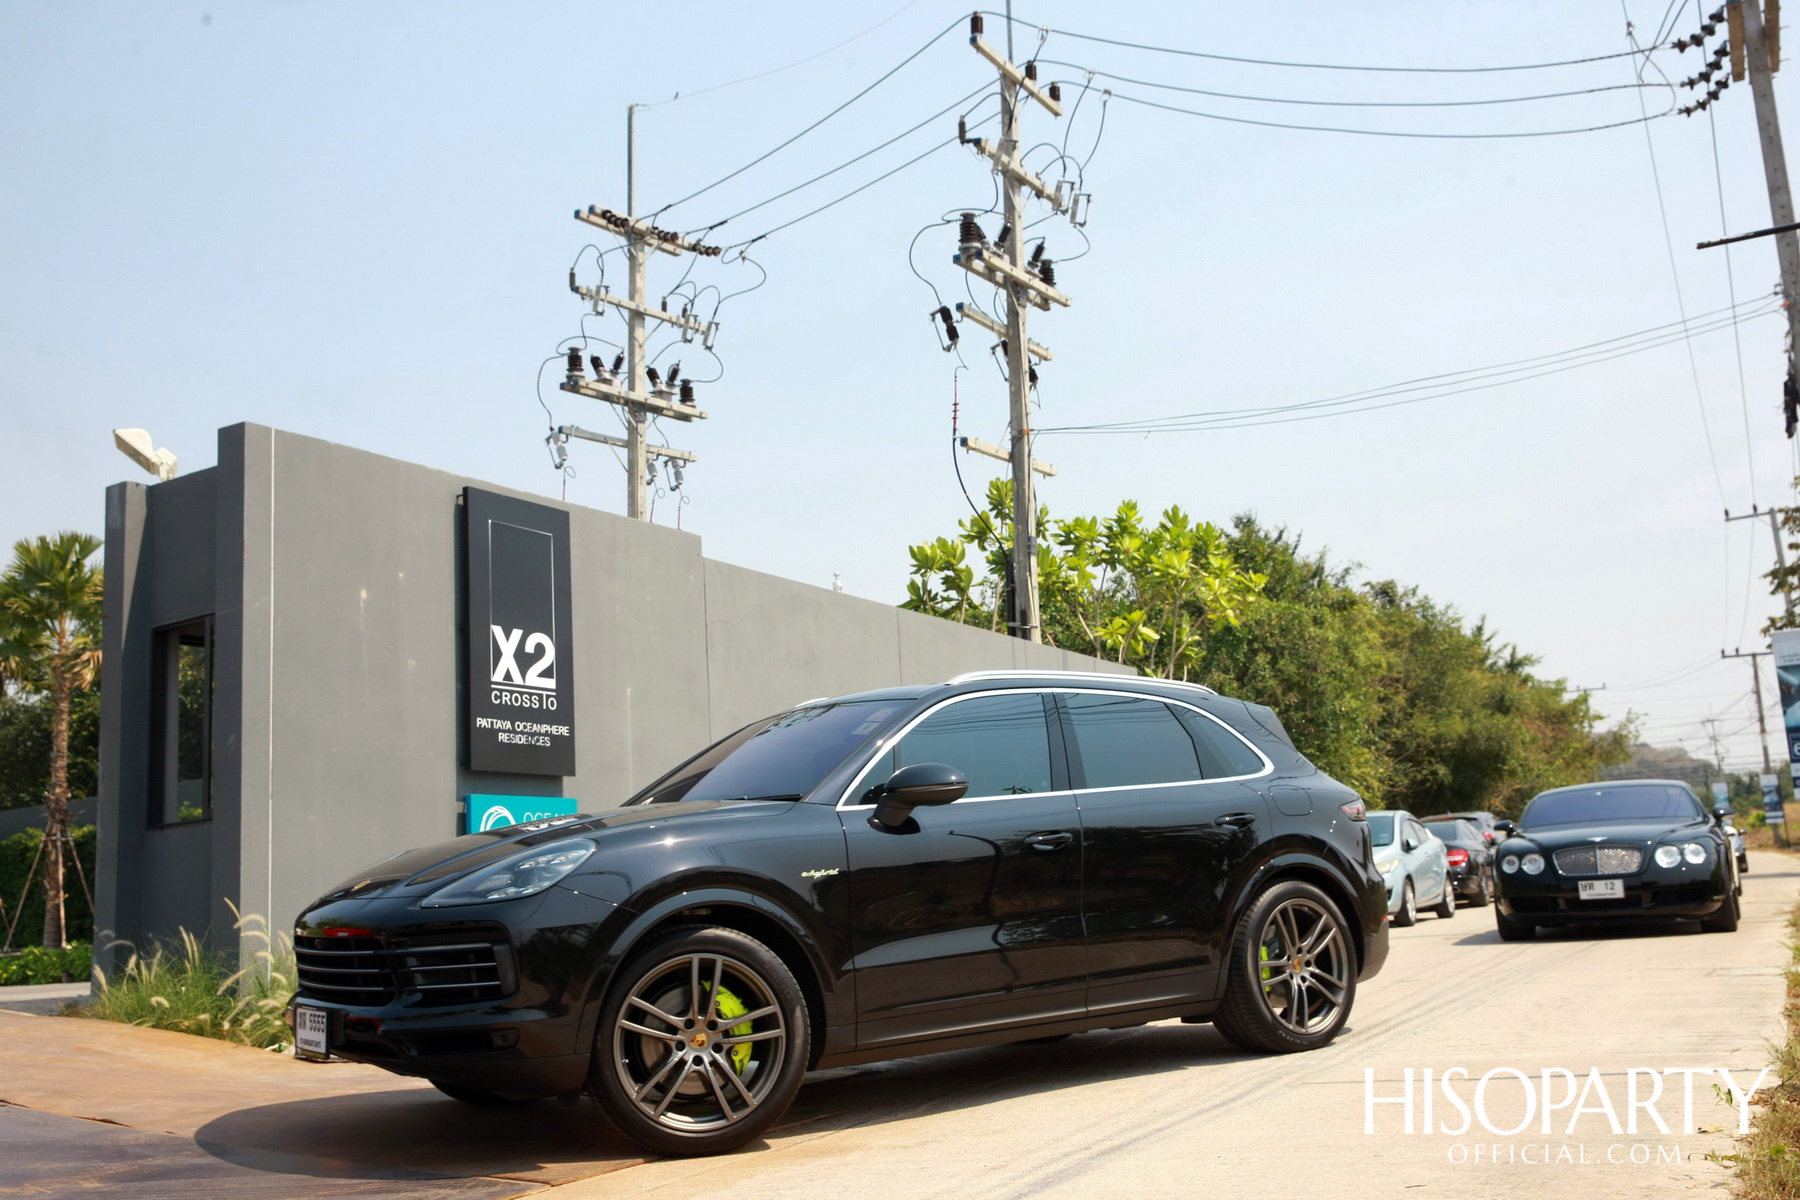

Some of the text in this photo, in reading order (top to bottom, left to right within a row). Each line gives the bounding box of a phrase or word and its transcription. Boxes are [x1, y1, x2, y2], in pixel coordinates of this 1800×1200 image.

[490, 624, 556, 690] X2
[476, 717, 570, 737] PATTAYA OCEANPHERE
[498, 732, 551, 747] RESIDENCES
[309, 1012, 326, 1034] 5555
